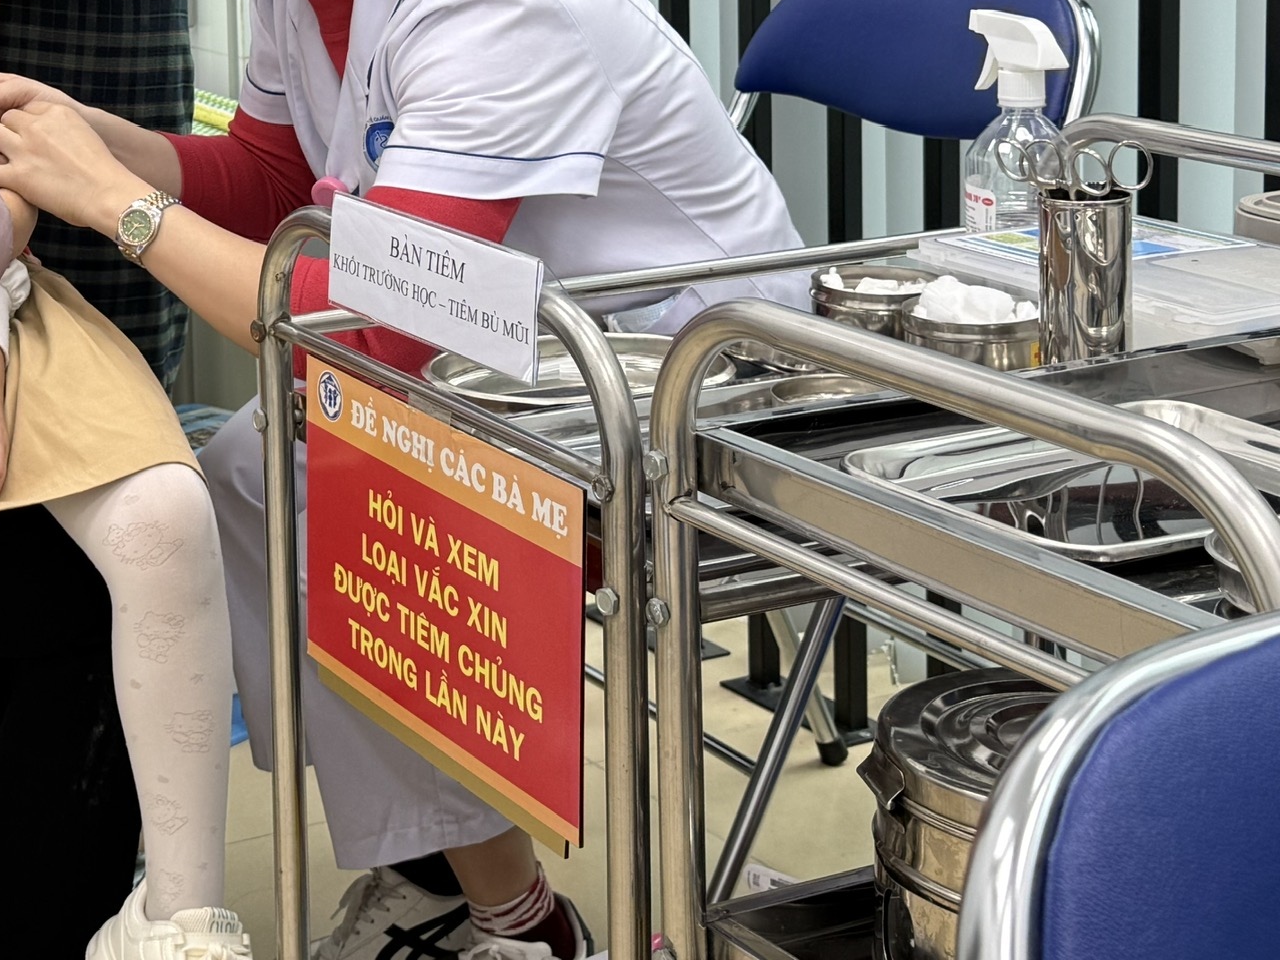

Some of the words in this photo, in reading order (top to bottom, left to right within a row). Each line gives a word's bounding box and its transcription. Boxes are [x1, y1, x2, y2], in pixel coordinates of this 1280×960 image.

[333, 252, 360, 276] KHỐI
[363, 264, 409, 297] TRƯỜNG
[412, 283, 437, 309] HỌC
[448, 298, 479, 325] TIÊM
[481, 310, 500, 333] BÙ
[389, 235, 423, 267] BÀN
[426, 250, 467, 284] TIÊM
[350, 396, 378, 437] ĐỀ
[382, 416, 436, 474] NGHỊ
[439, 447, 487, 493] CÁC
[491, 472, 526, 515] BÀ
[531, 492, 569, 540] MẸ
[362, 533, 407, 587] LOẠI
[414, 565, 459, 617] VẮC
[467, 596, 507, 649] XIN
[368, 489, 404, 535] HỎI
[410, 514, 441, 557] VÀ
[447, 534, 499, 592] XEM
[333, 562, 390, 623] ĐƯỢC
[396, 602, 450, 664] TIÊM
[457, 644, 544, 724] CHỦNG
[347, 617, 418, 691] TRONG
[425, 670, 468, 726] LẦN
[476, 704, 525, 762] NÀY
